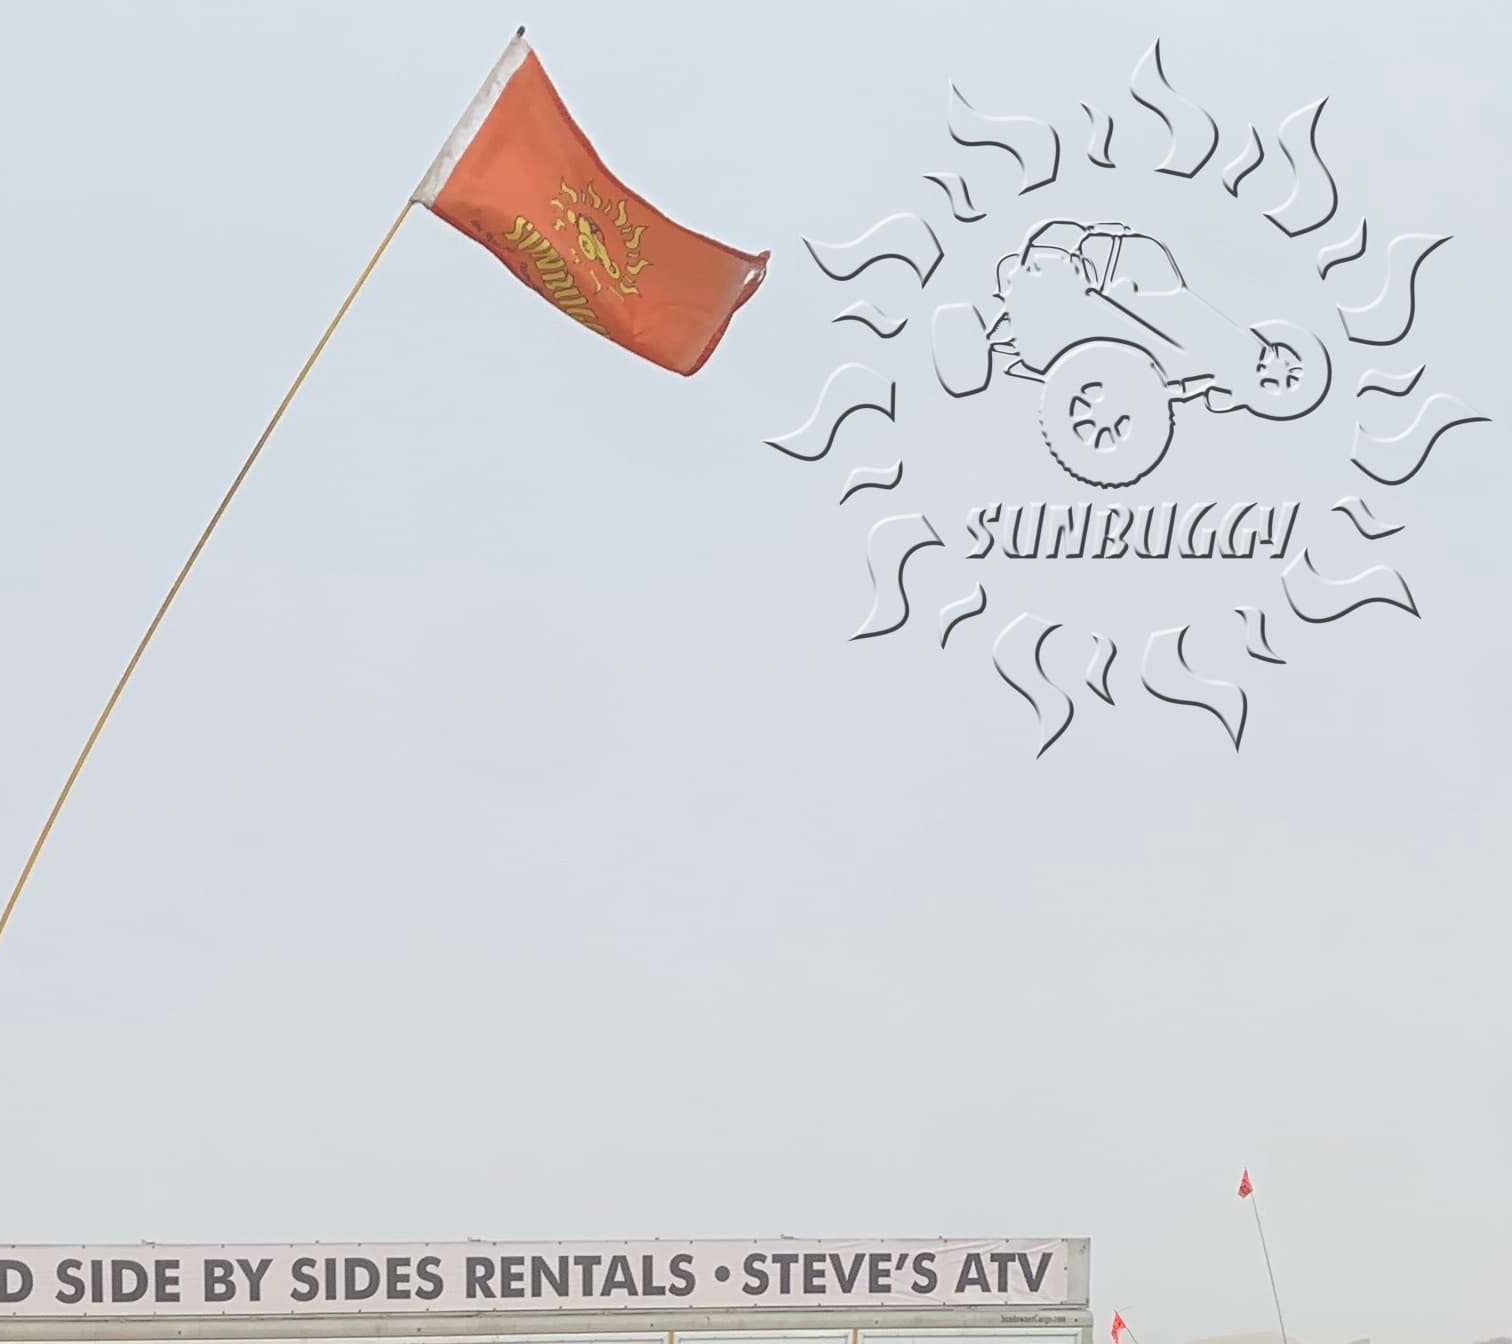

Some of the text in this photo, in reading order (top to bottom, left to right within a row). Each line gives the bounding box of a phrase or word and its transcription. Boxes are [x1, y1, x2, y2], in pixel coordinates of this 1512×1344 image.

[55, 1258, 181, 1305] SIDE
[203, 1258, 273, 1303] BY
[290, 1255, 444, 1303] SIDES
[465, 1253, 696, 1300] RENTALS
[741, 1252, 938, 1297] STEVE'S
[954, 1251, 1053, 1295] ATV
